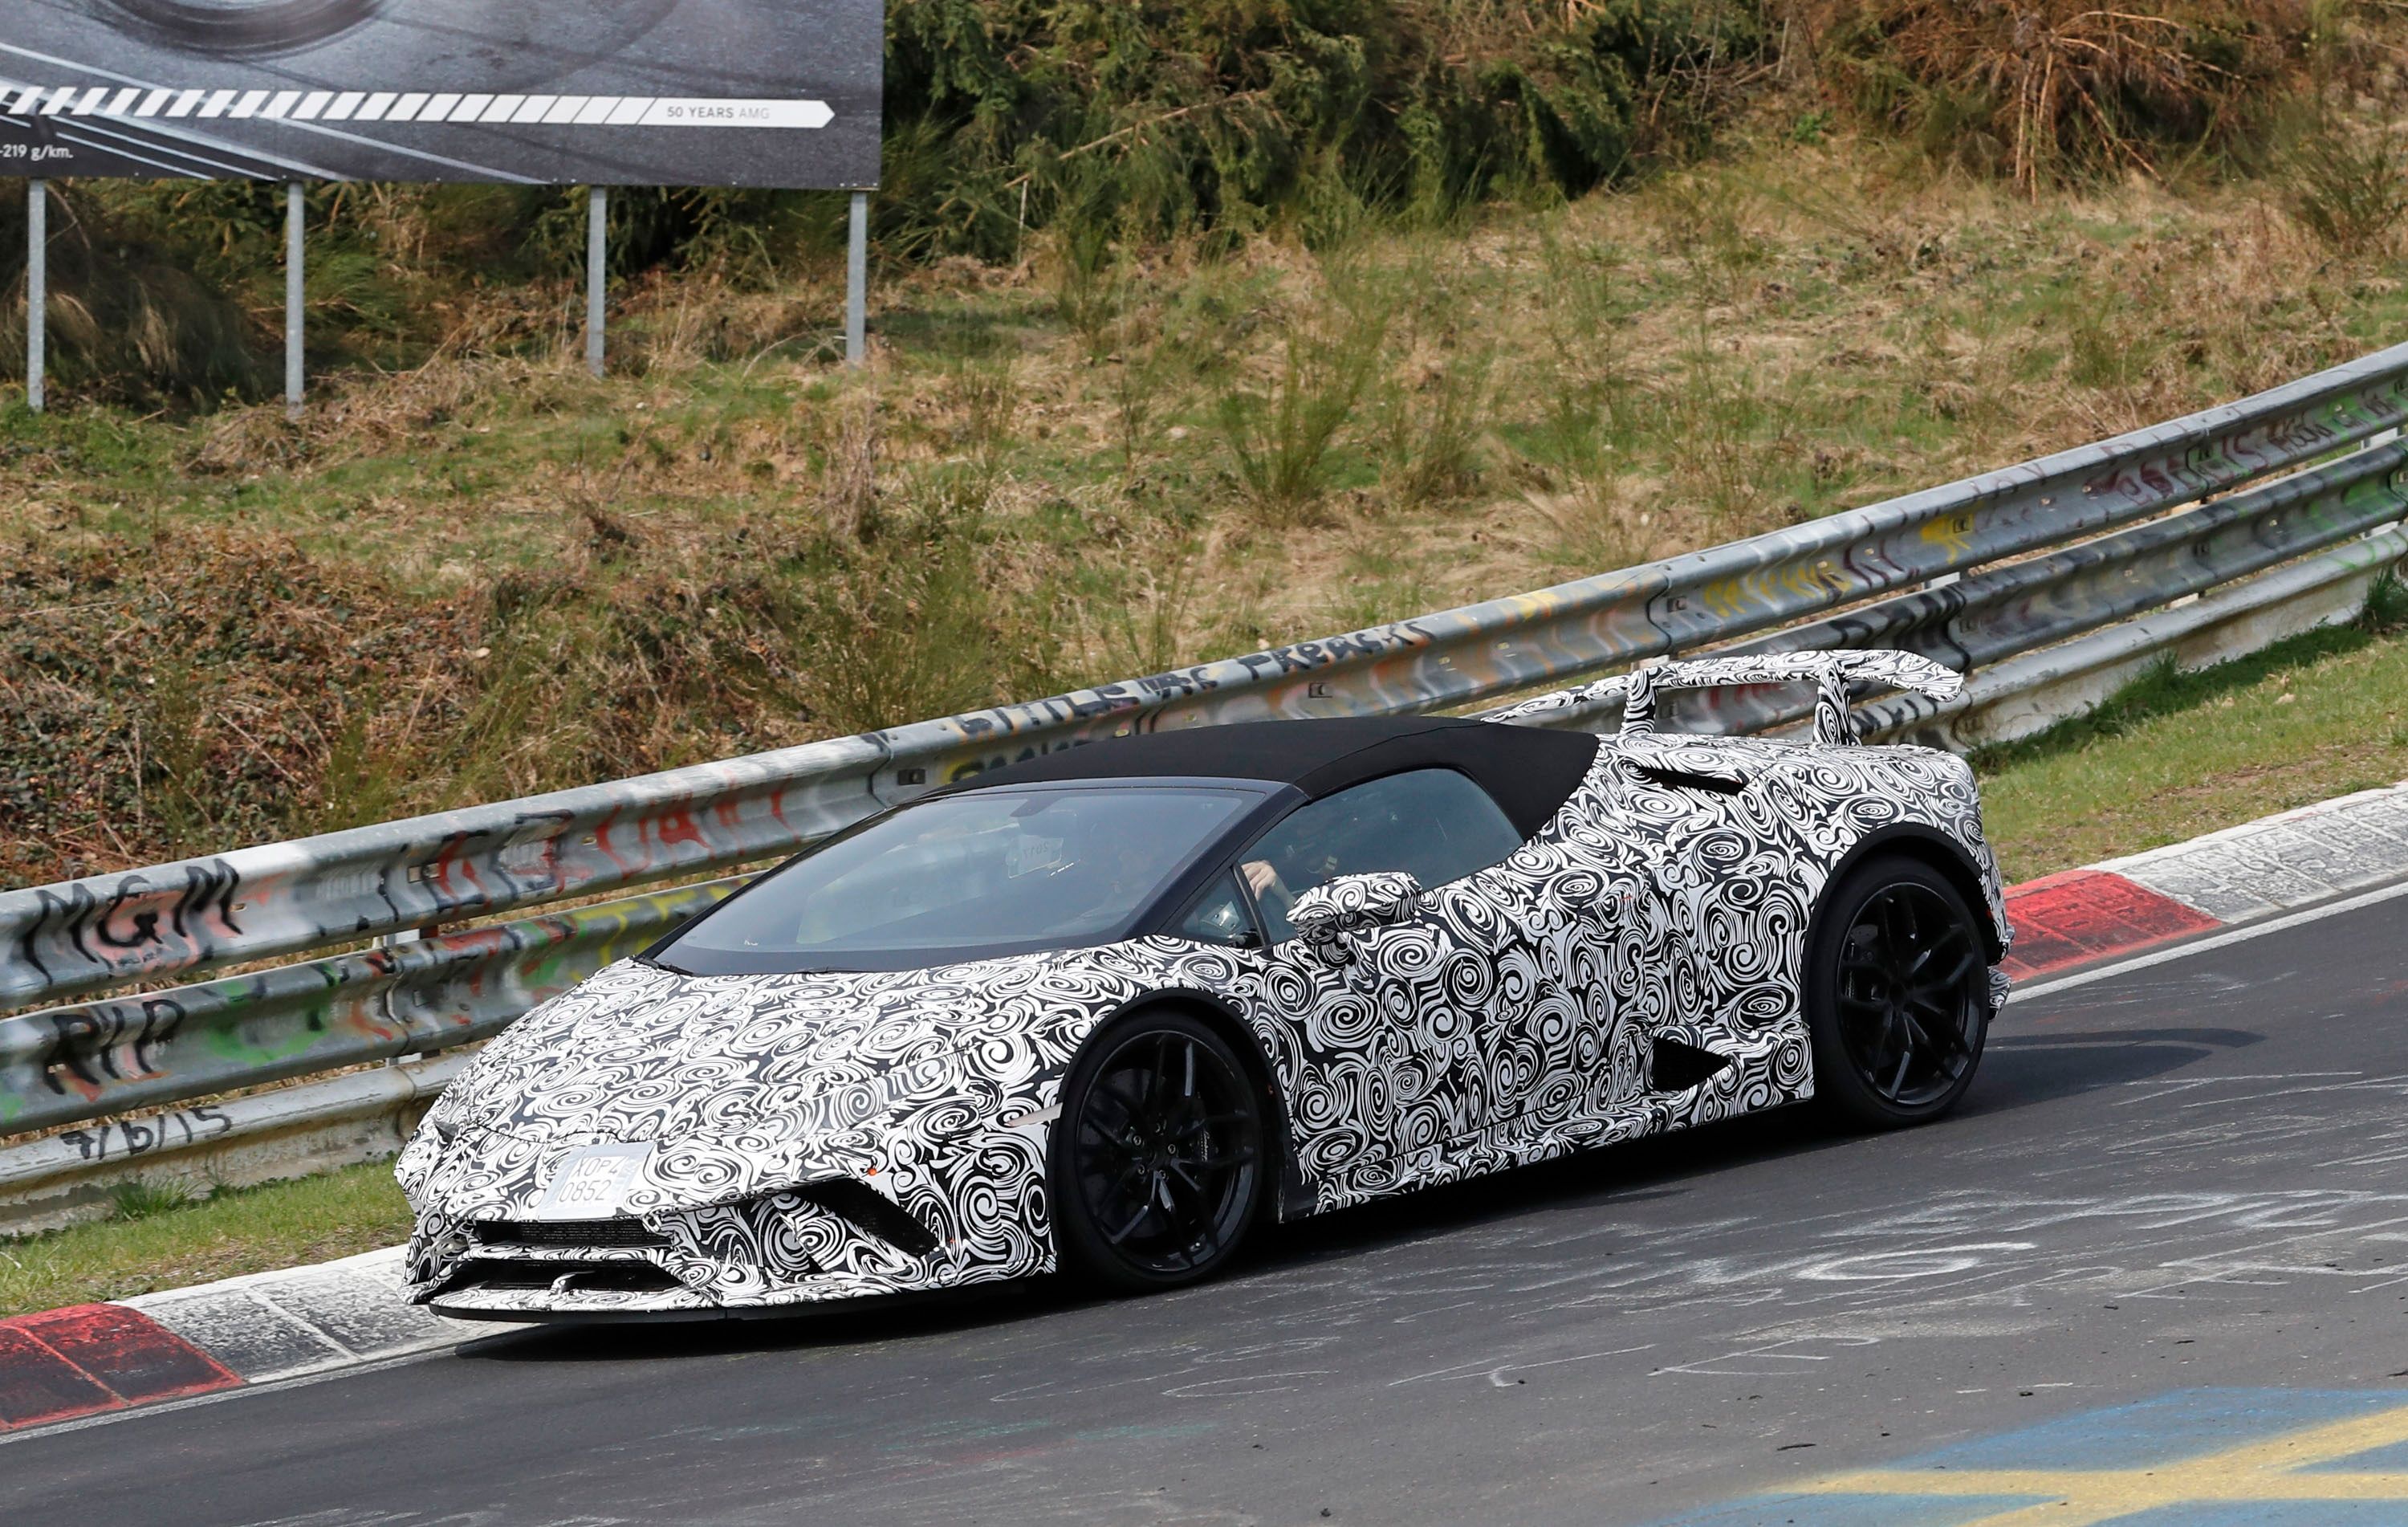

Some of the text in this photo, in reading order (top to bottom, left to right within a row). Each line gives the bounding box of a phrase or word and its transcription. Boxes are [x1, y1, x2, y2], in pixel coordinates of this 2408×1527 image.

[667, 106, 771, 120] 50 YEARS AMG
[31, 144, 74, 161] g/km.
[559, 1179, 612, 1203] 0852
